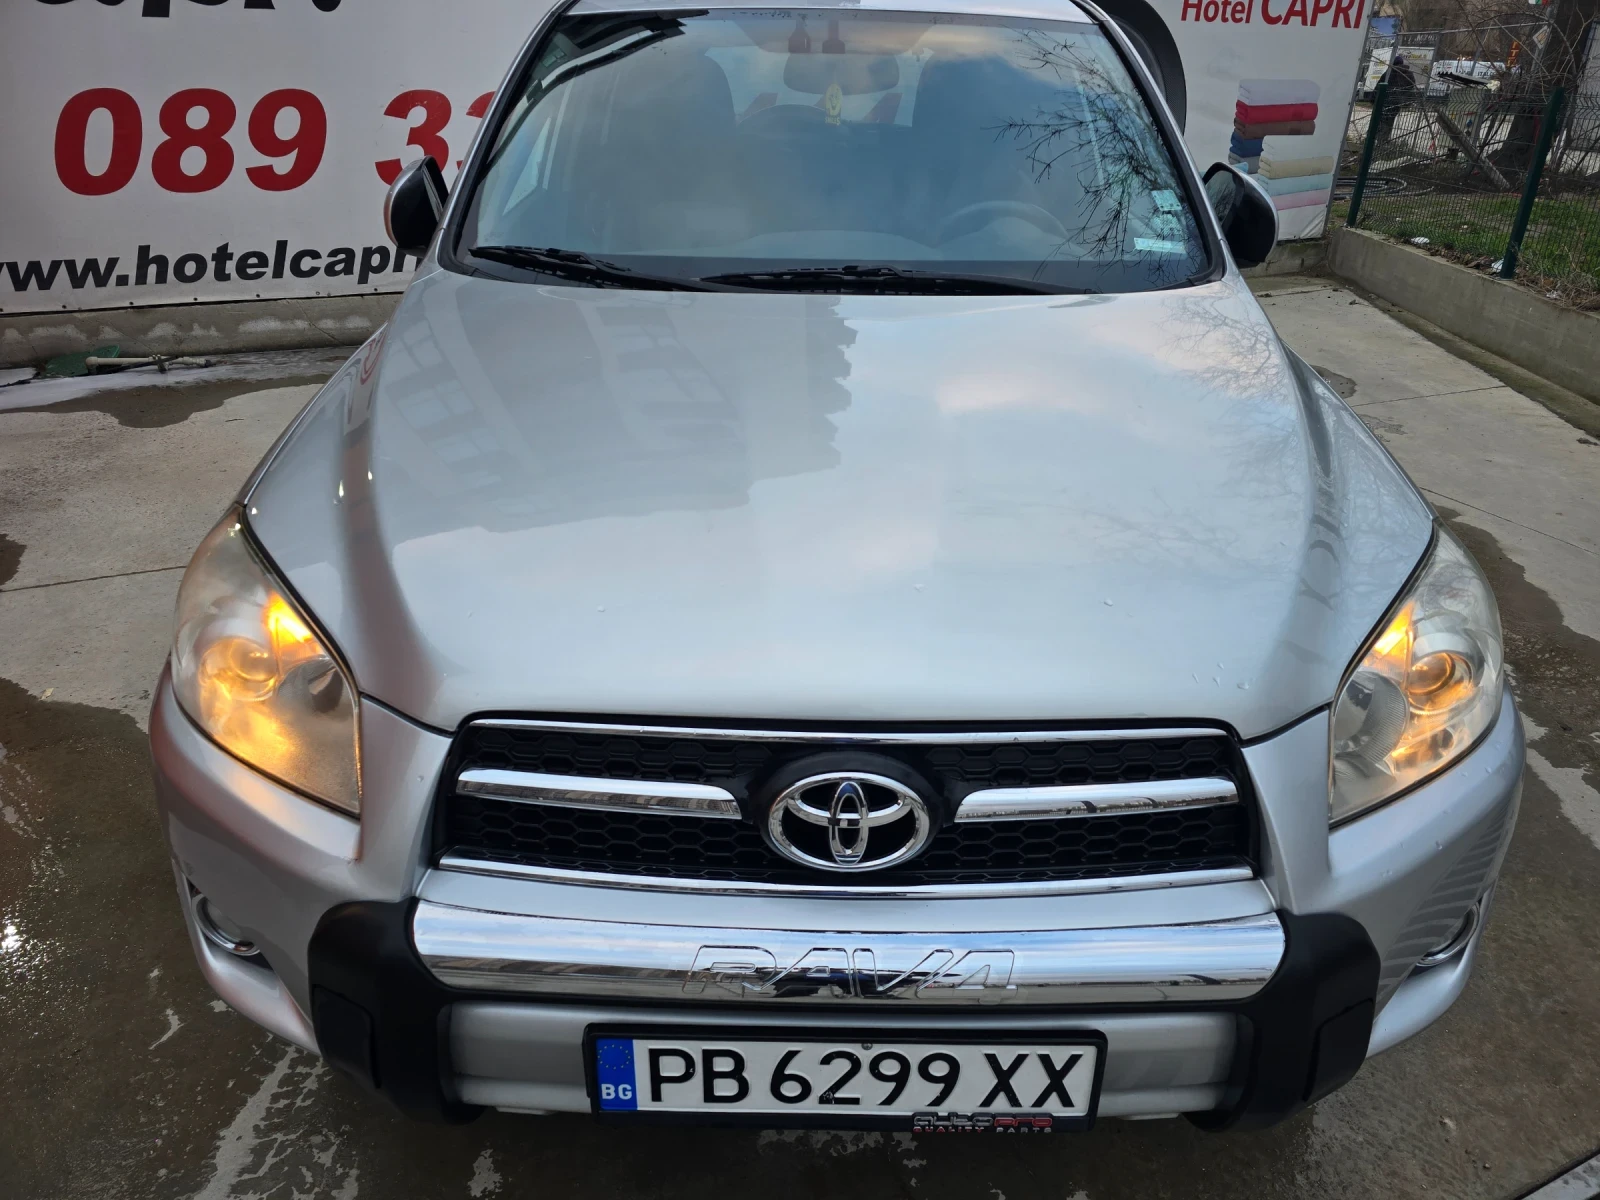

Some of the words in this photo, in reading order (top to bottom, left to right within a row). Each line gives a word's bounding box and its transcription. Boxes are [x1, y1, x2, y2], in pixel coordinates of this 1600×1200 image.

[1181, 0, 1254, 23] Hotel
[1261, 0, 1366, 29] CAPRI
[54, 88, 327, 196] 089
[0, 240, 424, 292] ww.hotelcapr
[682, 945, 1018, 1003] RAV4
[601, 1083, 633, 1101] BG
[648, 1047, 750, 1103] PB
[770, 1049, 961, 1107] 6299
[978, 1053, 1084, 1108] XX
[996, 1126, 1052, 1134] PARTS
